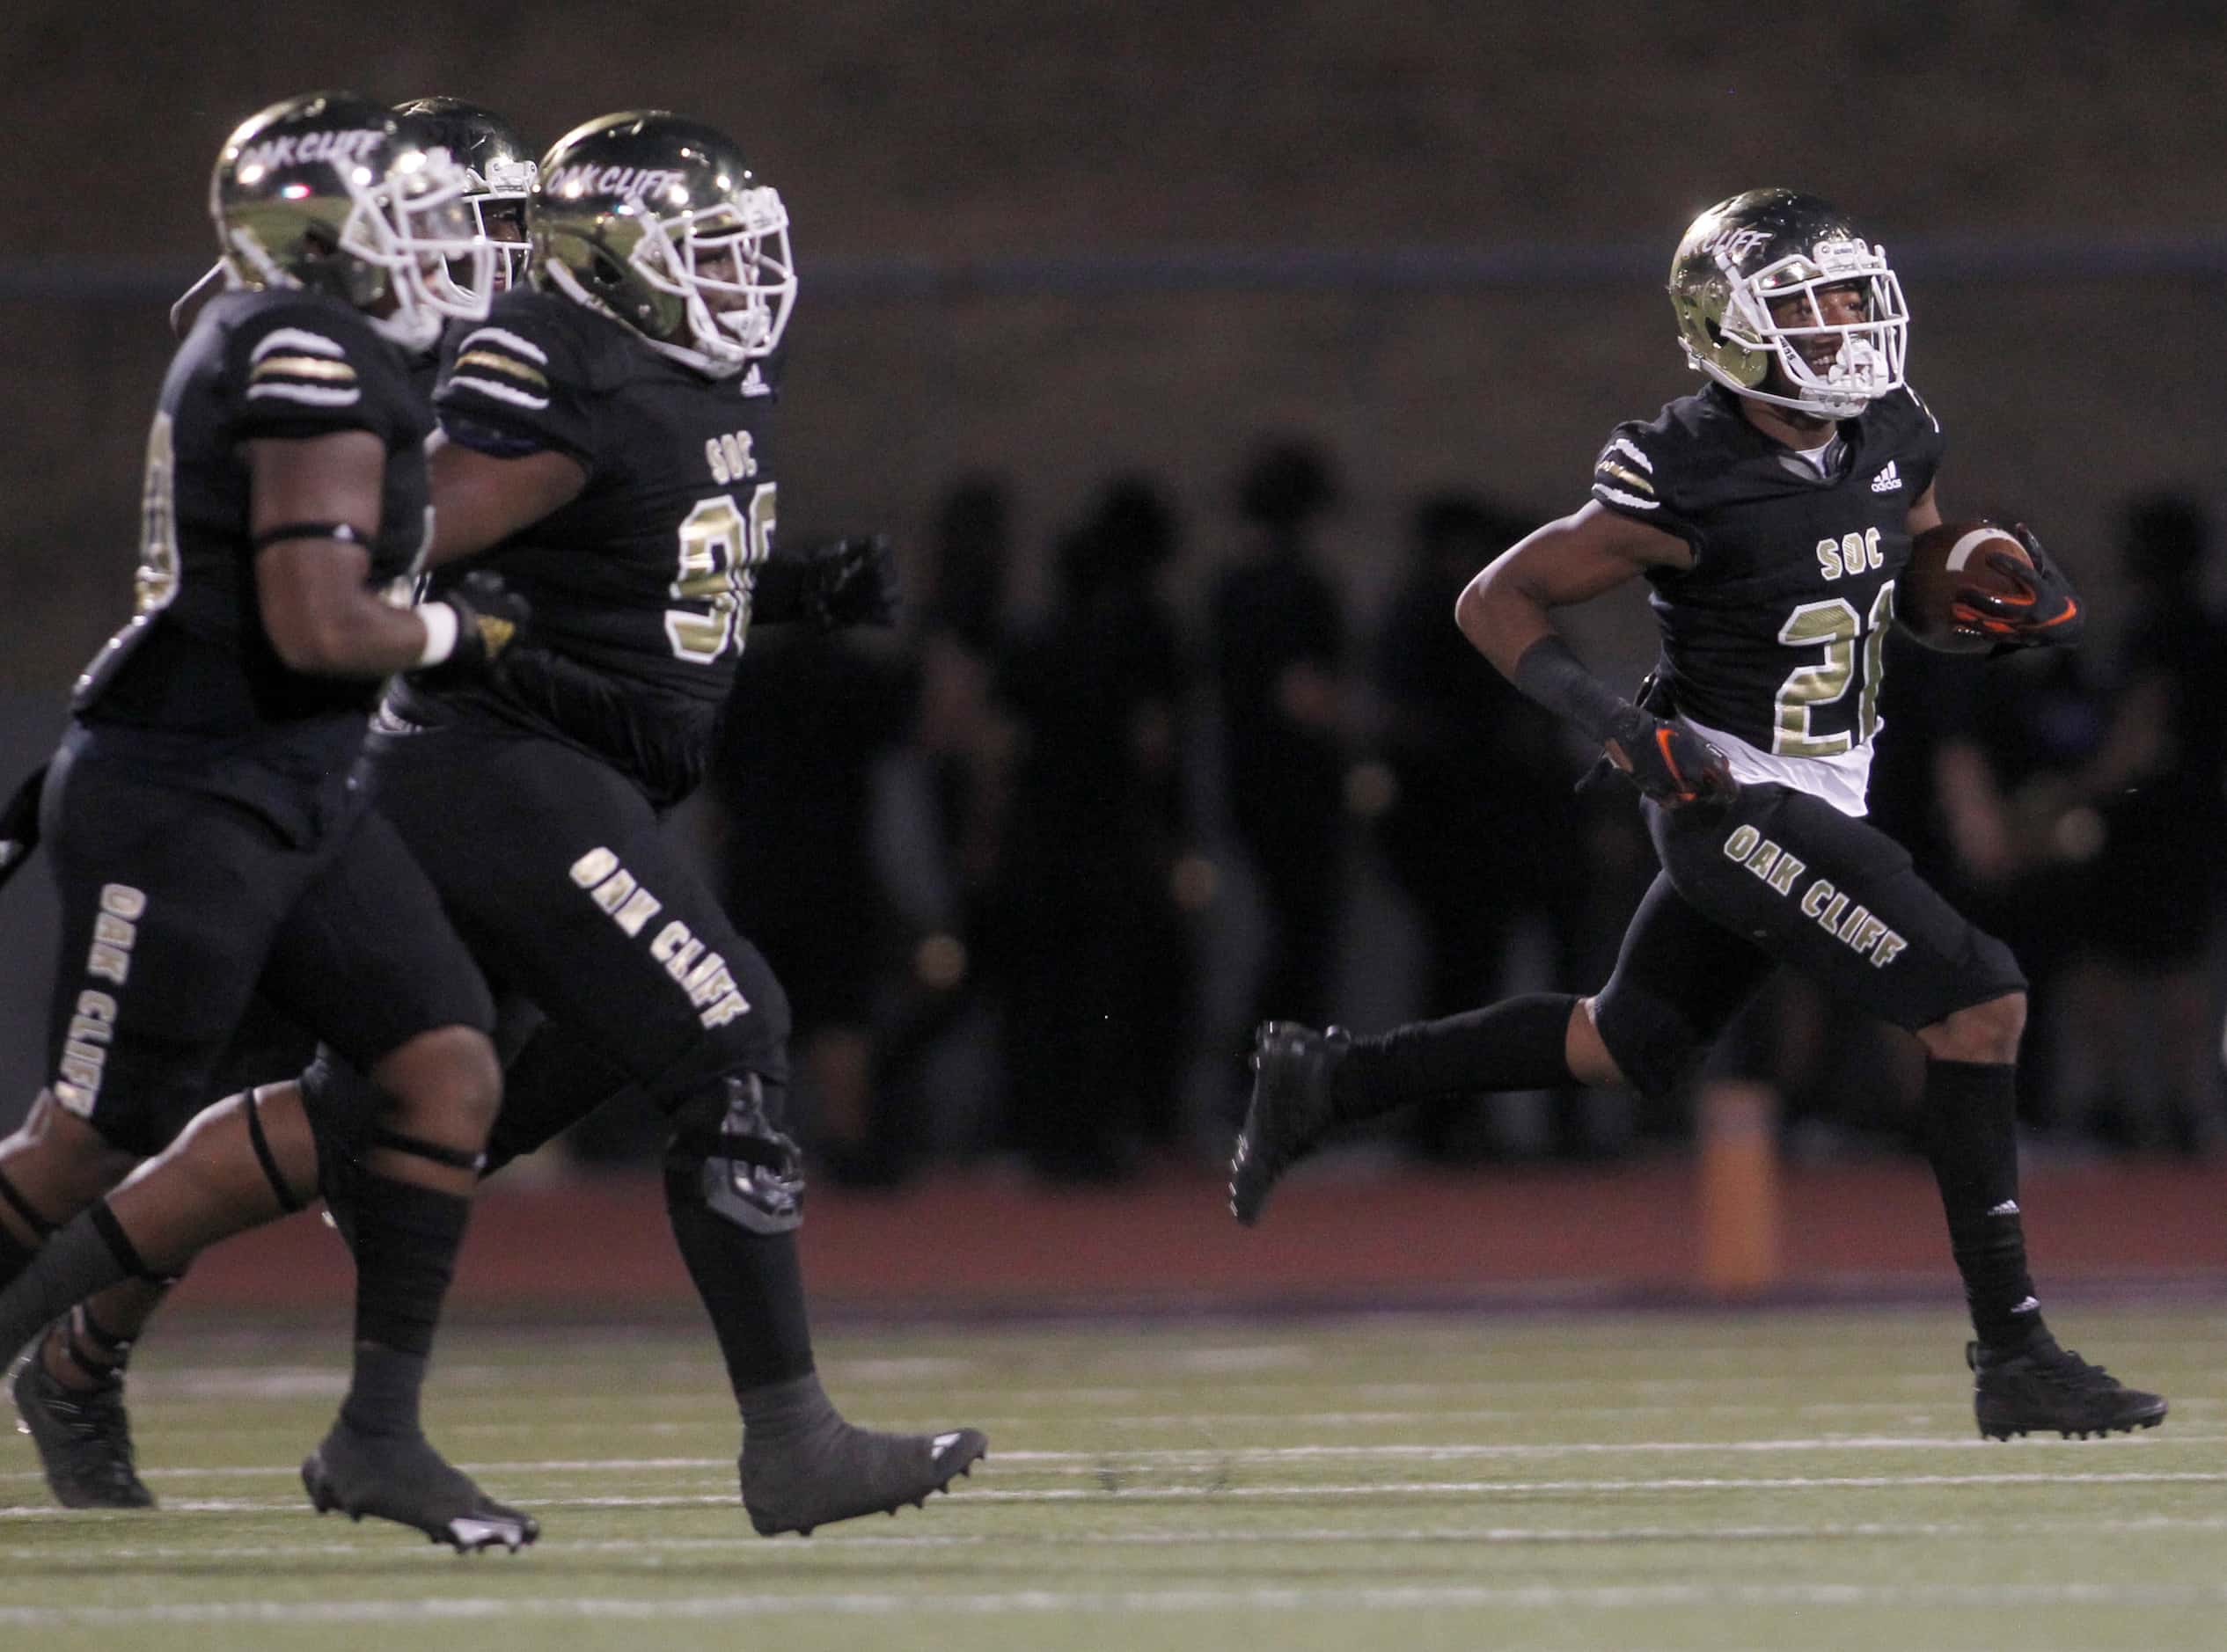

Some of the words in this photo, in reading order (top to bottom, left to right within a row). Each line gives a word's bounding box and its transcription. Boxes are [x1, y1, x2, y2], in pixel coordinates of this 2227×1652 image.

[296, 129, 385, 164] CLIFF
[597, 165, 685, 204] CLIFF
[706, 429, 758, 485] SOC
[1871, 478, 1901, 493] adidas
[1816, 527, 1884, 581] SOC
[1771, 579, 1895, 758] 21
[87, 882, 147, 986] OAK
[1723, 823, 1806, 896] OAK
[1800, 879, 1908, 969] CLIFF
[568, 845, 663, 939] OAK
[649, 919, 751, 1030] CLIFF
[54, 989, 118, 1118] CLIFF
